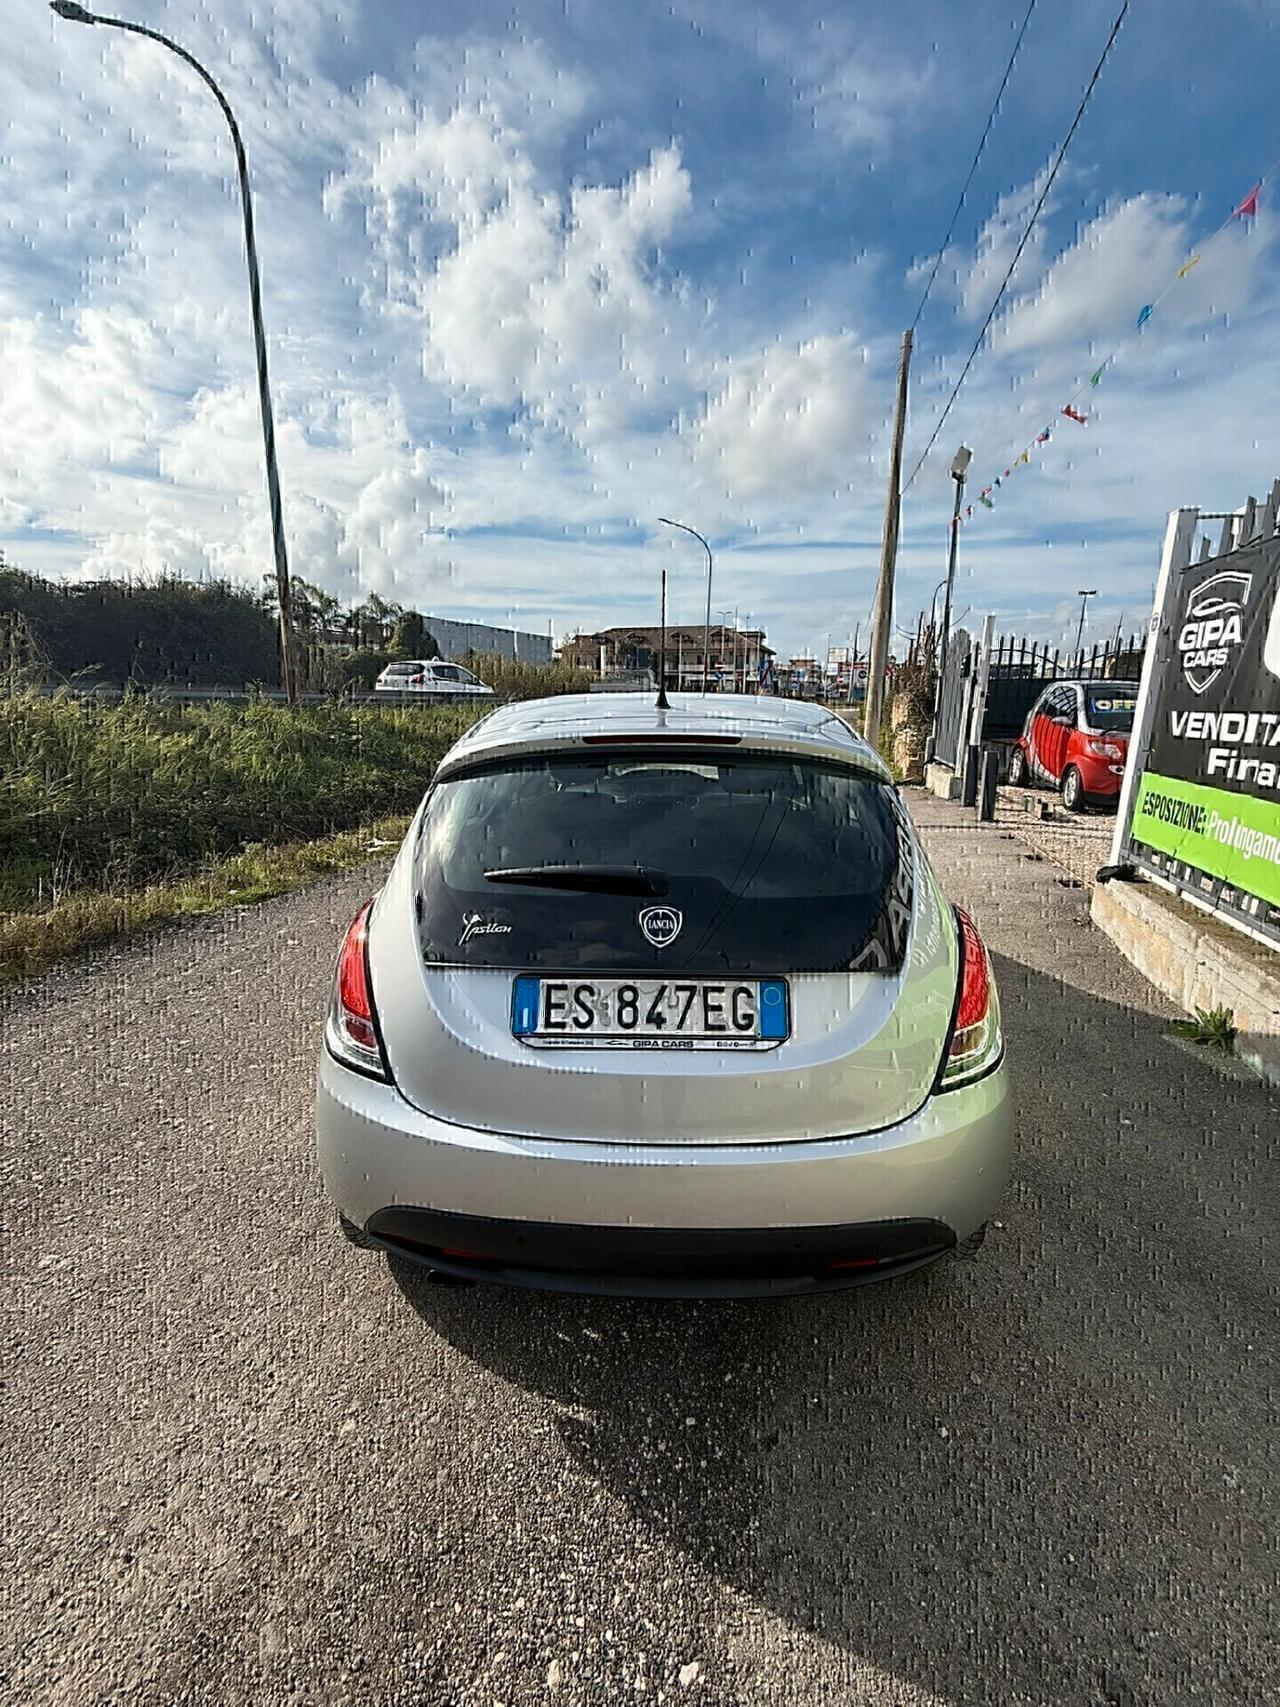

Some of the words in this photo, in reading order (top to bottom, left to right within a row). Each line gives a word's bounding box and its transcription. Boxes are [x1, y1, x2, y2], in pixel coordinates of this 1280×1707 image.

[1178, 615, 1242, 651] GIPA
[1183, 647, 1229, 668] CARS
[1207, 748, 1280, 790] Fina
[1141, 791, 1207, 835] ESPOSIZIONE:
[458, 912, 512, 947] Ypsilon
[648, 919, 675, 930] LANCIA
[543, 983, 595, 1030] ES
[616, 984, 755, 1032] 847EG
[632, 1040, 660, 1048] GIPA
[661, 1040, 694, 1048] CARS
